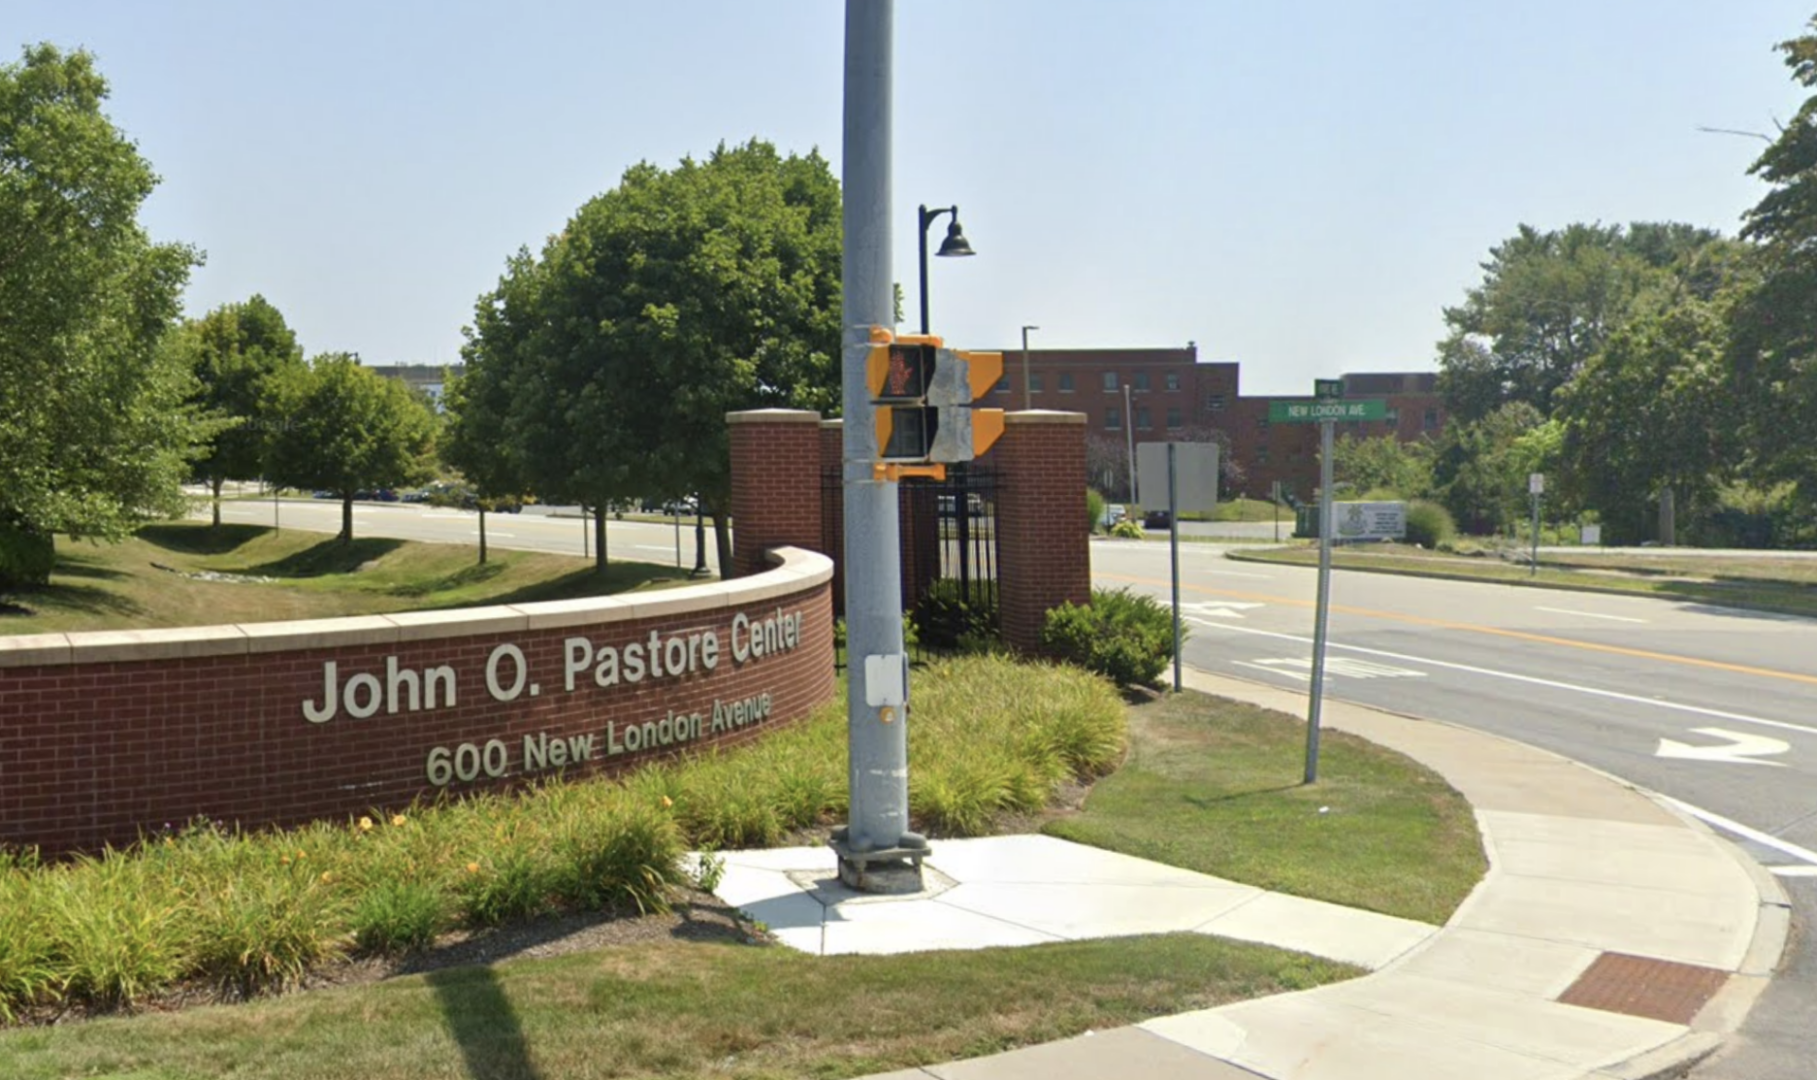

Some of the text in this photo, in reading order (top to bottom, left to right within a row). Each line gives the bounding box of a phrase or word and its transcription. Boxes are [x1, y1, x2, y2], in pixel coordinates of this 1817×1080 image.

[1288, 405, 1308, 417] NEW
[1311, 404, 1346, 416] LONDON
[303, 606, 802, 723] John O. Pastore Center
[426, 692, 771, 787] 600 New London Avenue
